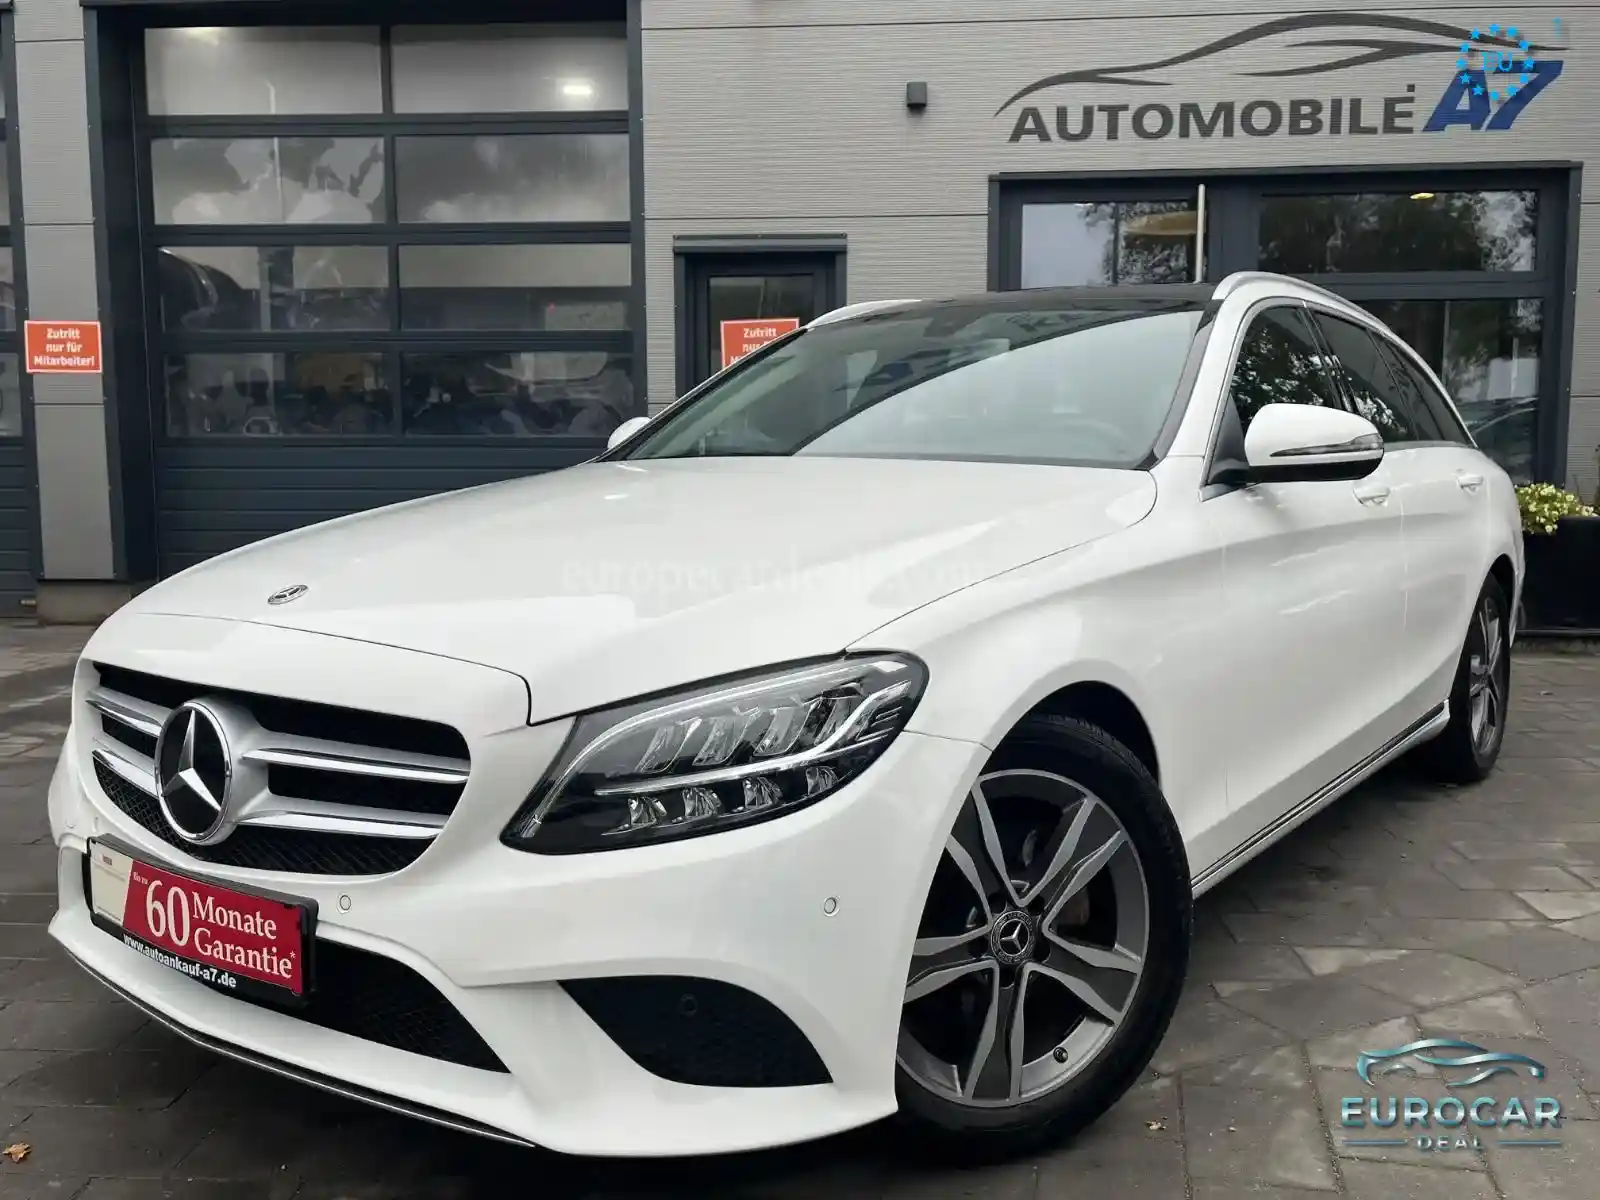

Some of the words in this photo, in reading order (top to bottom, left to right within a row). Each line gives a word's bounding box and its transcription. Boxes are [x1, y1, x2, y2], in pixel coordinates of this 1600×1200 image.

[1007, 96, 1416, 143] AUTOMOBILE
[1421, 60, 1564, 132] A7
[45, 343, 64, 353] nur
[66, 340, 83, 353] für
[46, 327, 81, 340] Zutritt
[743, 327, 777, 338] Zutritt
[33, 355, 95, 367] Mitarbeiter!
[145, 879, 191, 947] 60
[191, 891, 278, 940] Monate
[123, 932, 237, 989] www.autoankauf-a7.de
